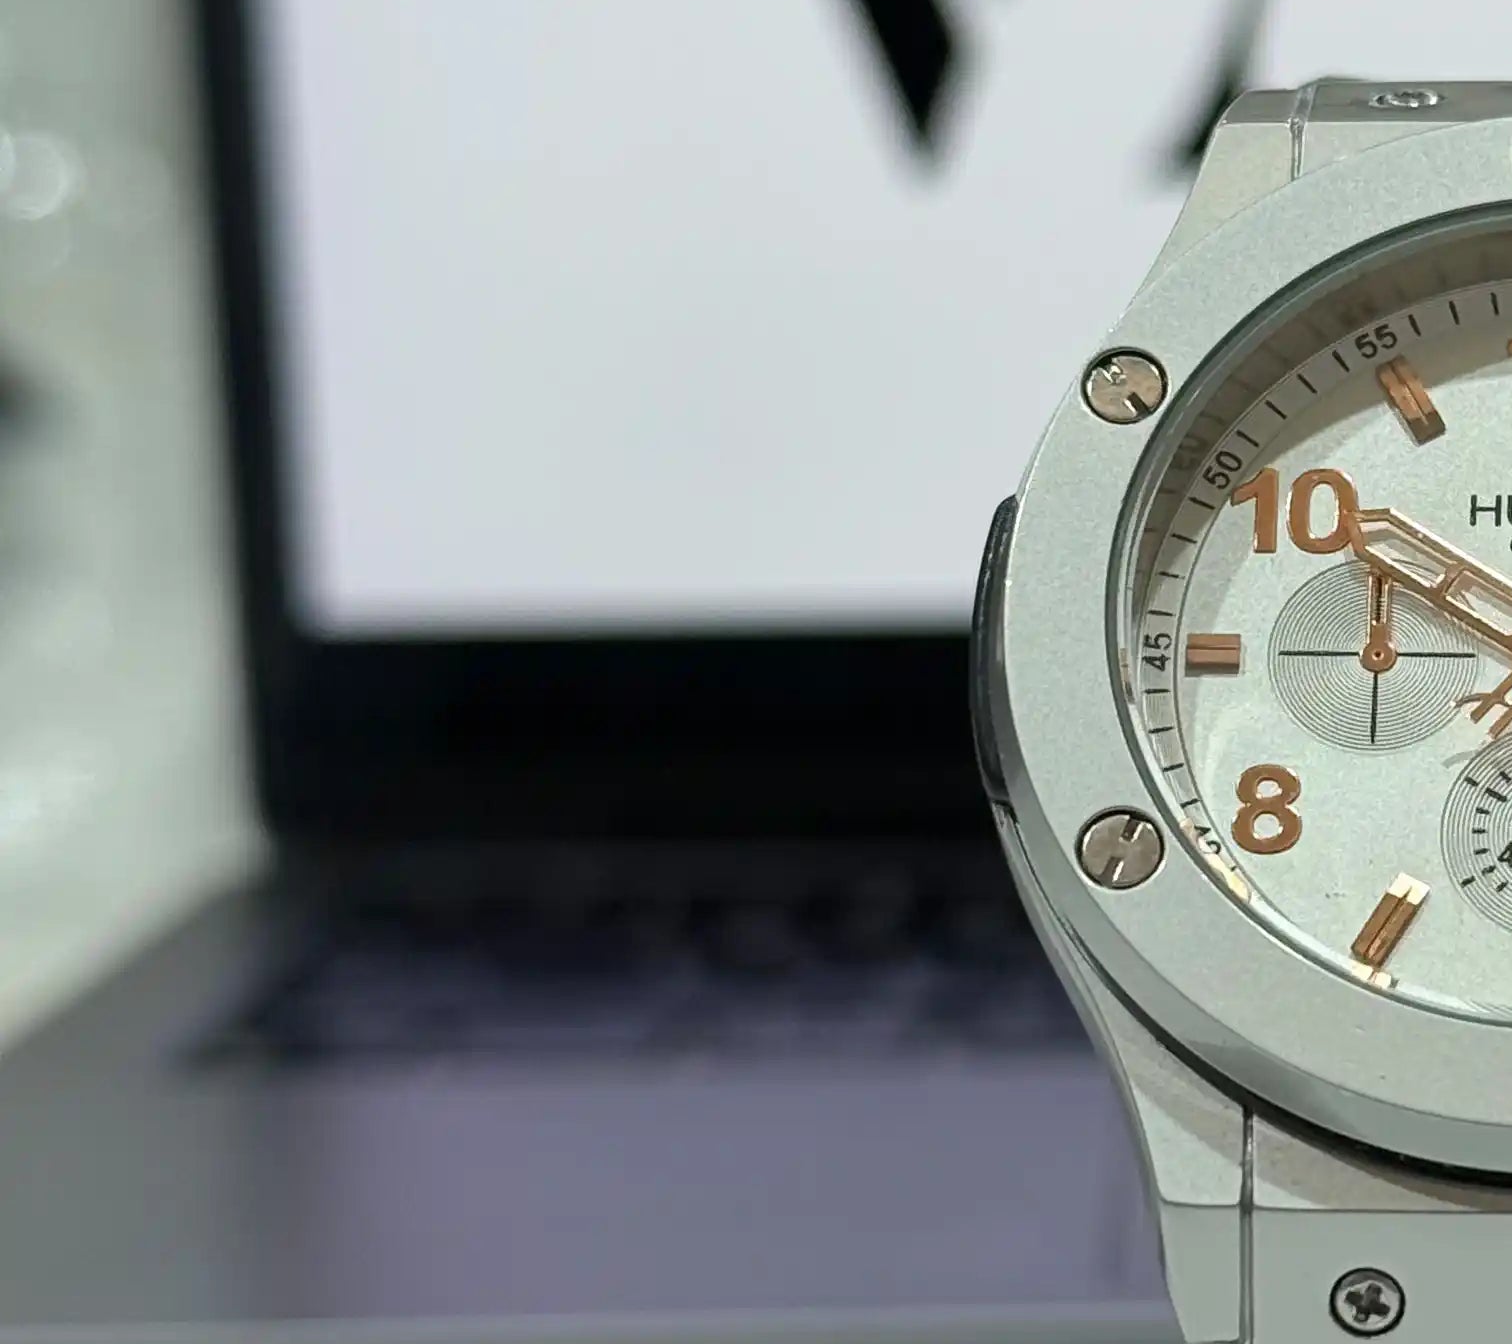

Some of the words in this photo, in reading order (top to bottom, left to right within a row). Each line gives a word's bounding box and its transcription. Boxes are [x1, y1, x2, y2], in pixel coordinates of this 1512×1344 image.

[1355, 324, 1398, 360] 55
[1203, 450, 1243, 490] 50
[1231, 468, 1358, 554] 10
[1142, 632, 1173, 672] 45
[1231, 764, 1302, 854] 8
